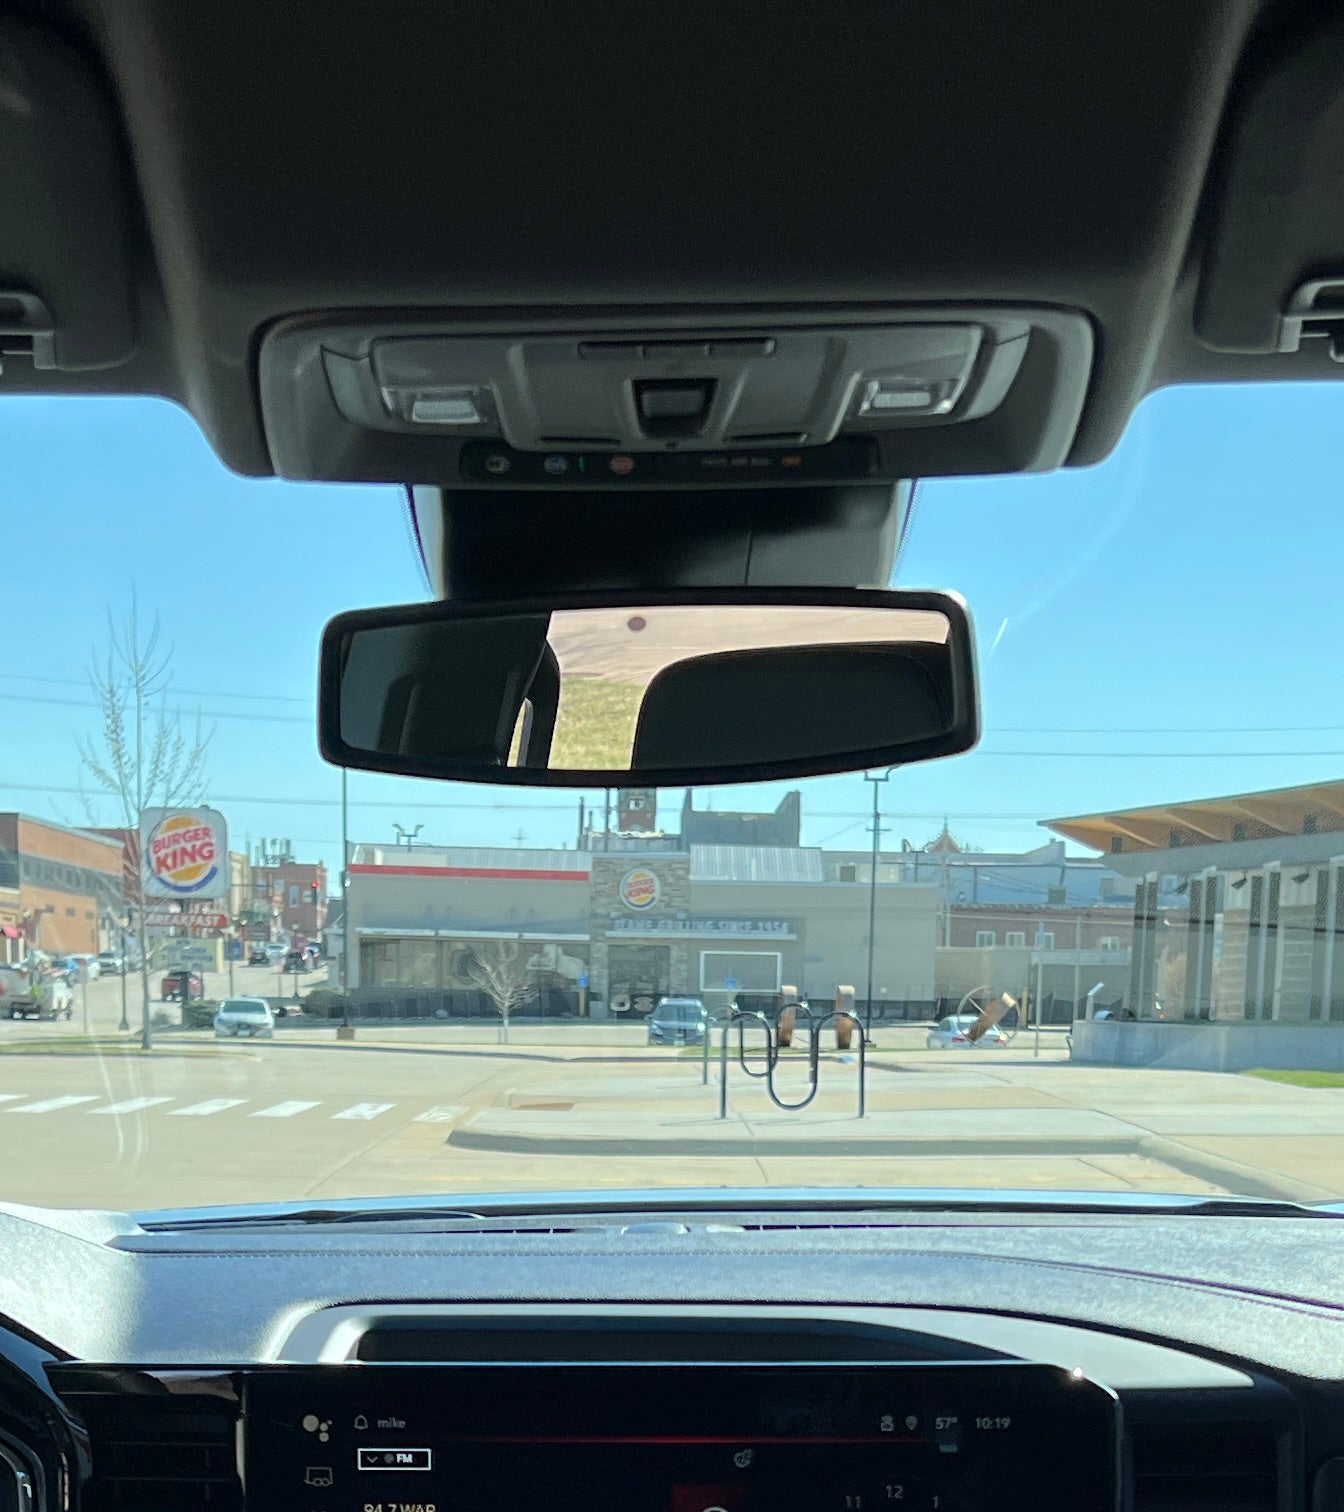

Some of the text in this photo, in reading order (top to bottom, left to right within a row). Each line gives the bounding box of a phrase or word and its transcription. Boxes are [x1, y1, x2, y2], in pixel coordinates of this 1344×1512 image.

[152, 827, 212, 855] BURGER
[156, 841, 215, 875] KING
[377, 1417, 406, 1428] mike
[975, 1417, 1011, 1429] 10:19
[396, 1453, 413, 1463] FM
[885, 1485, 904, 1499] 12
[845, 1495, 861, 1509] 11
[931, 1495, 939, 1509] 1
